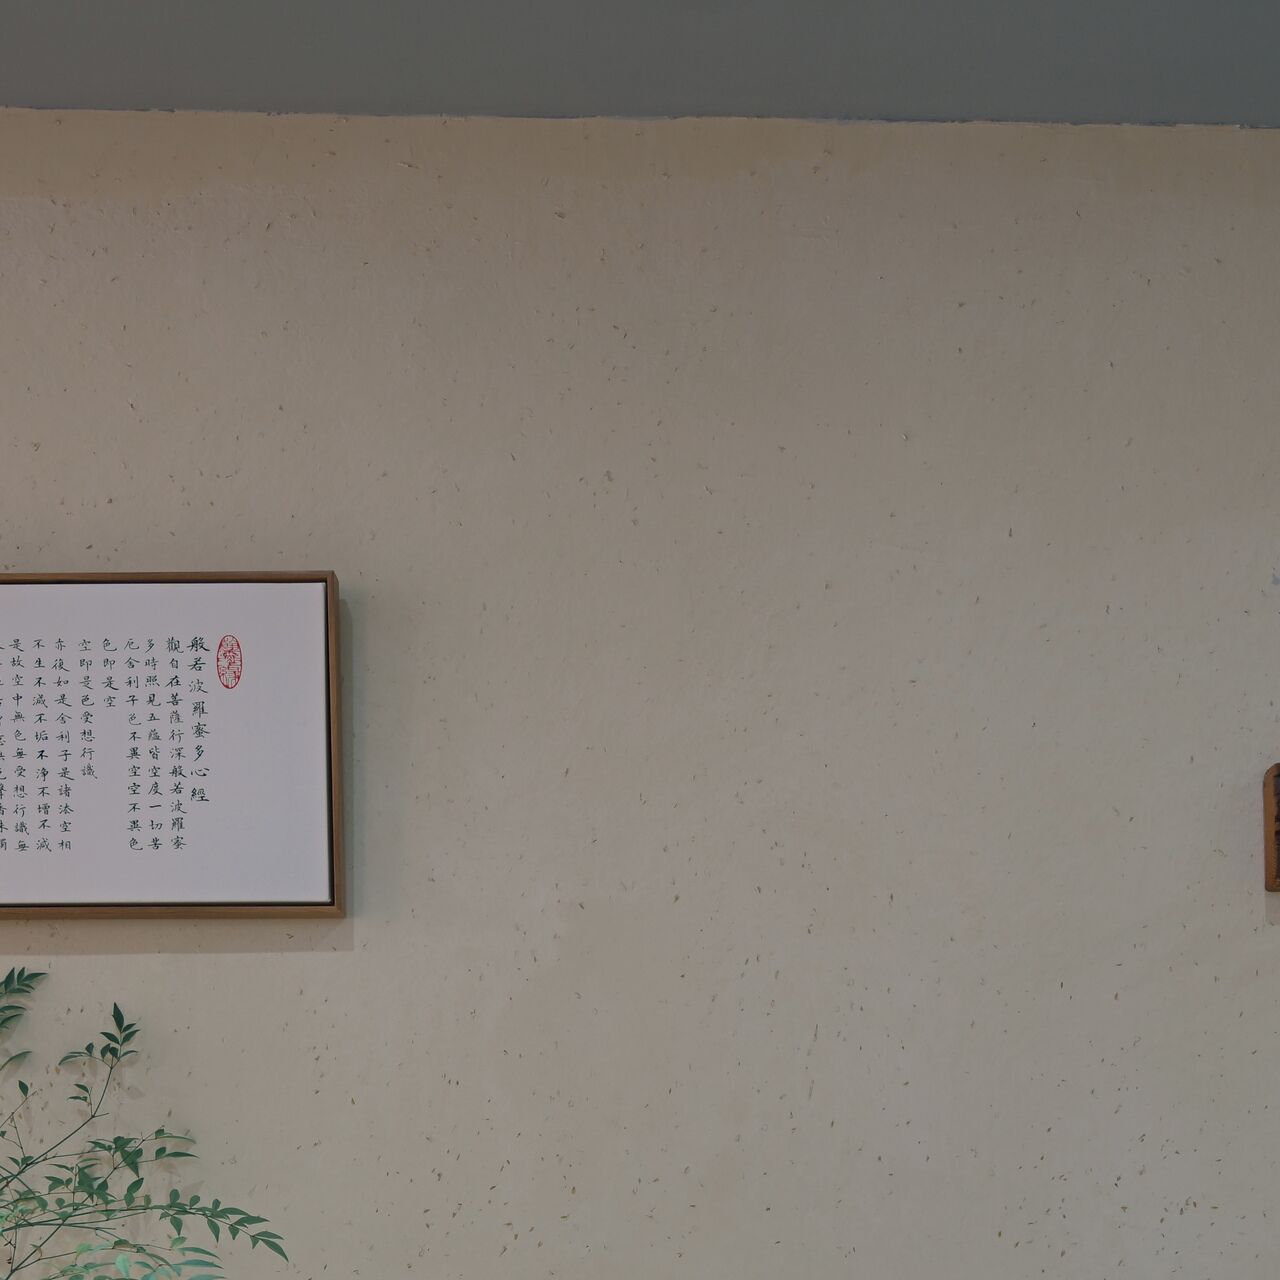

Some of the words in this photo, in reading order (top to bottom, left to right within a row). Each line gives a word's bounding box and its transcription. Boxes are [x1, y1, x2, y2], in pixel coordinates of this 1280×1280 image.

[186, 636, 211, 803] 般若波羅蜜多心經
